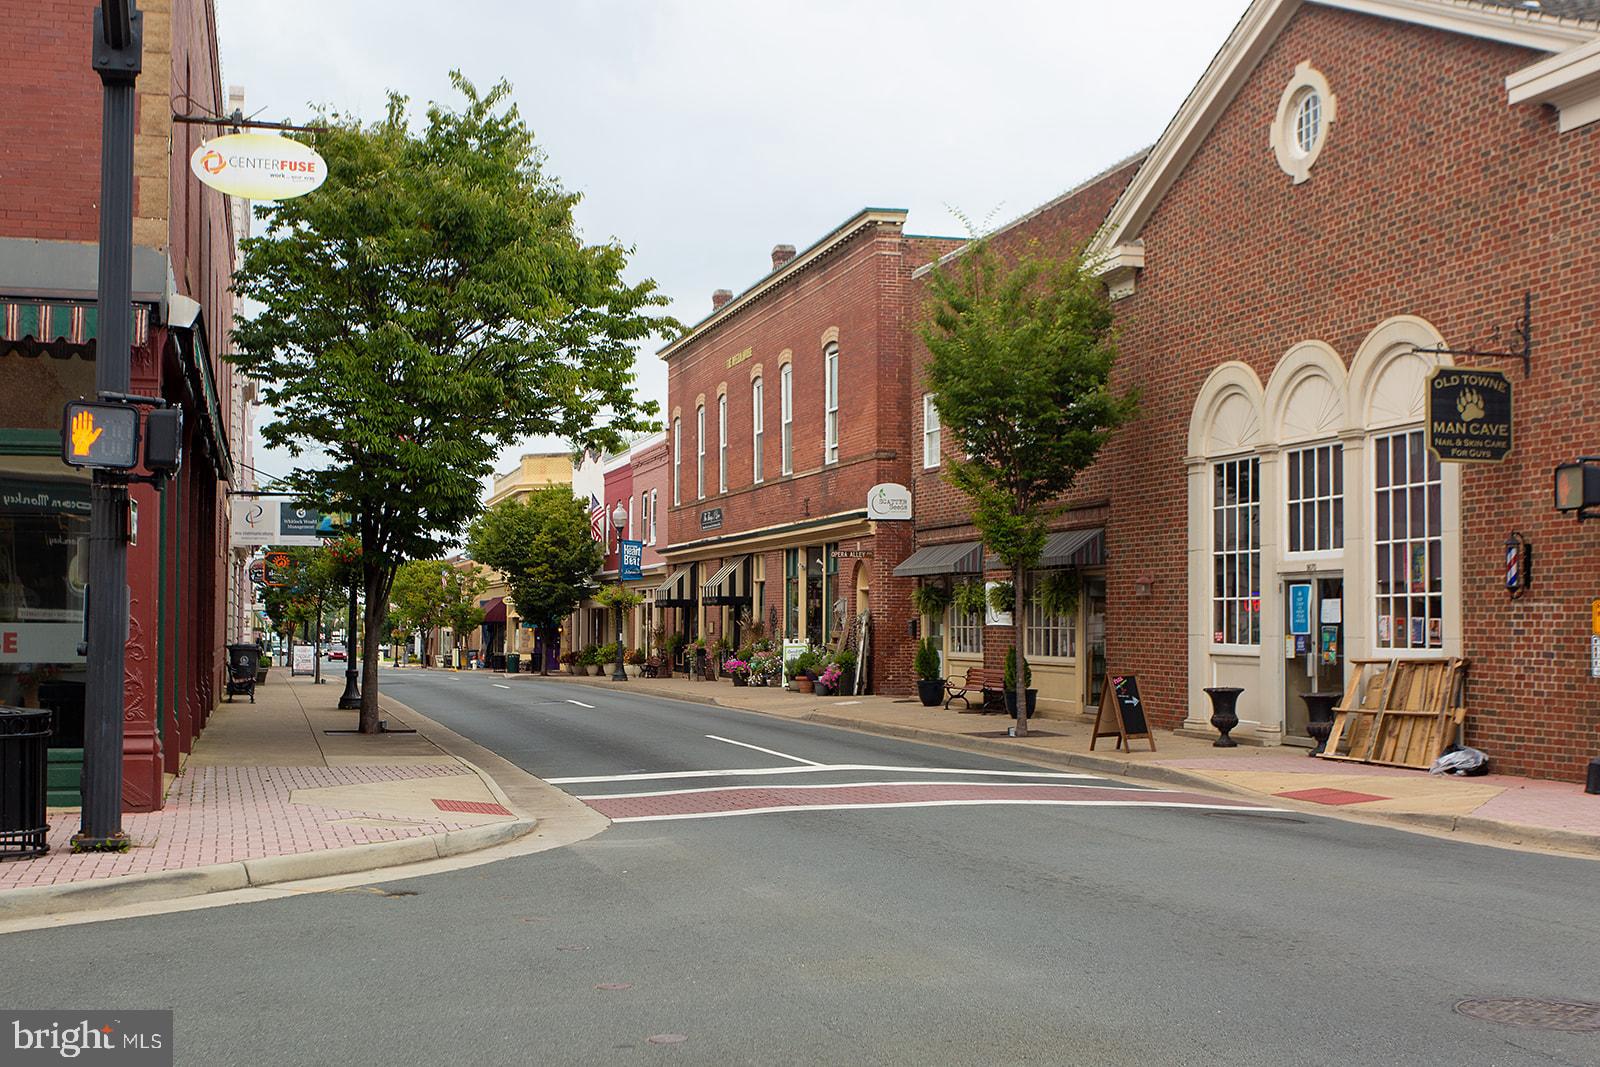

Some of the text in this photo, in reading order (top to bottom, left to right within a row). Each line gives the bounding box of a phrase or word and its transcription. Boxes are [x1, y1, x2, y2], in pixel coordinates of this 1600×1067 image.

[229, 156, 316, 173] CENTERFUSE
[1434, 374, 1508, 393] OLD TOWNE
[1433, 421, 1509, 436] MAN CAVE
[1455, 439, 1463, 447] &
[624, 544, 641, 557] Heart
